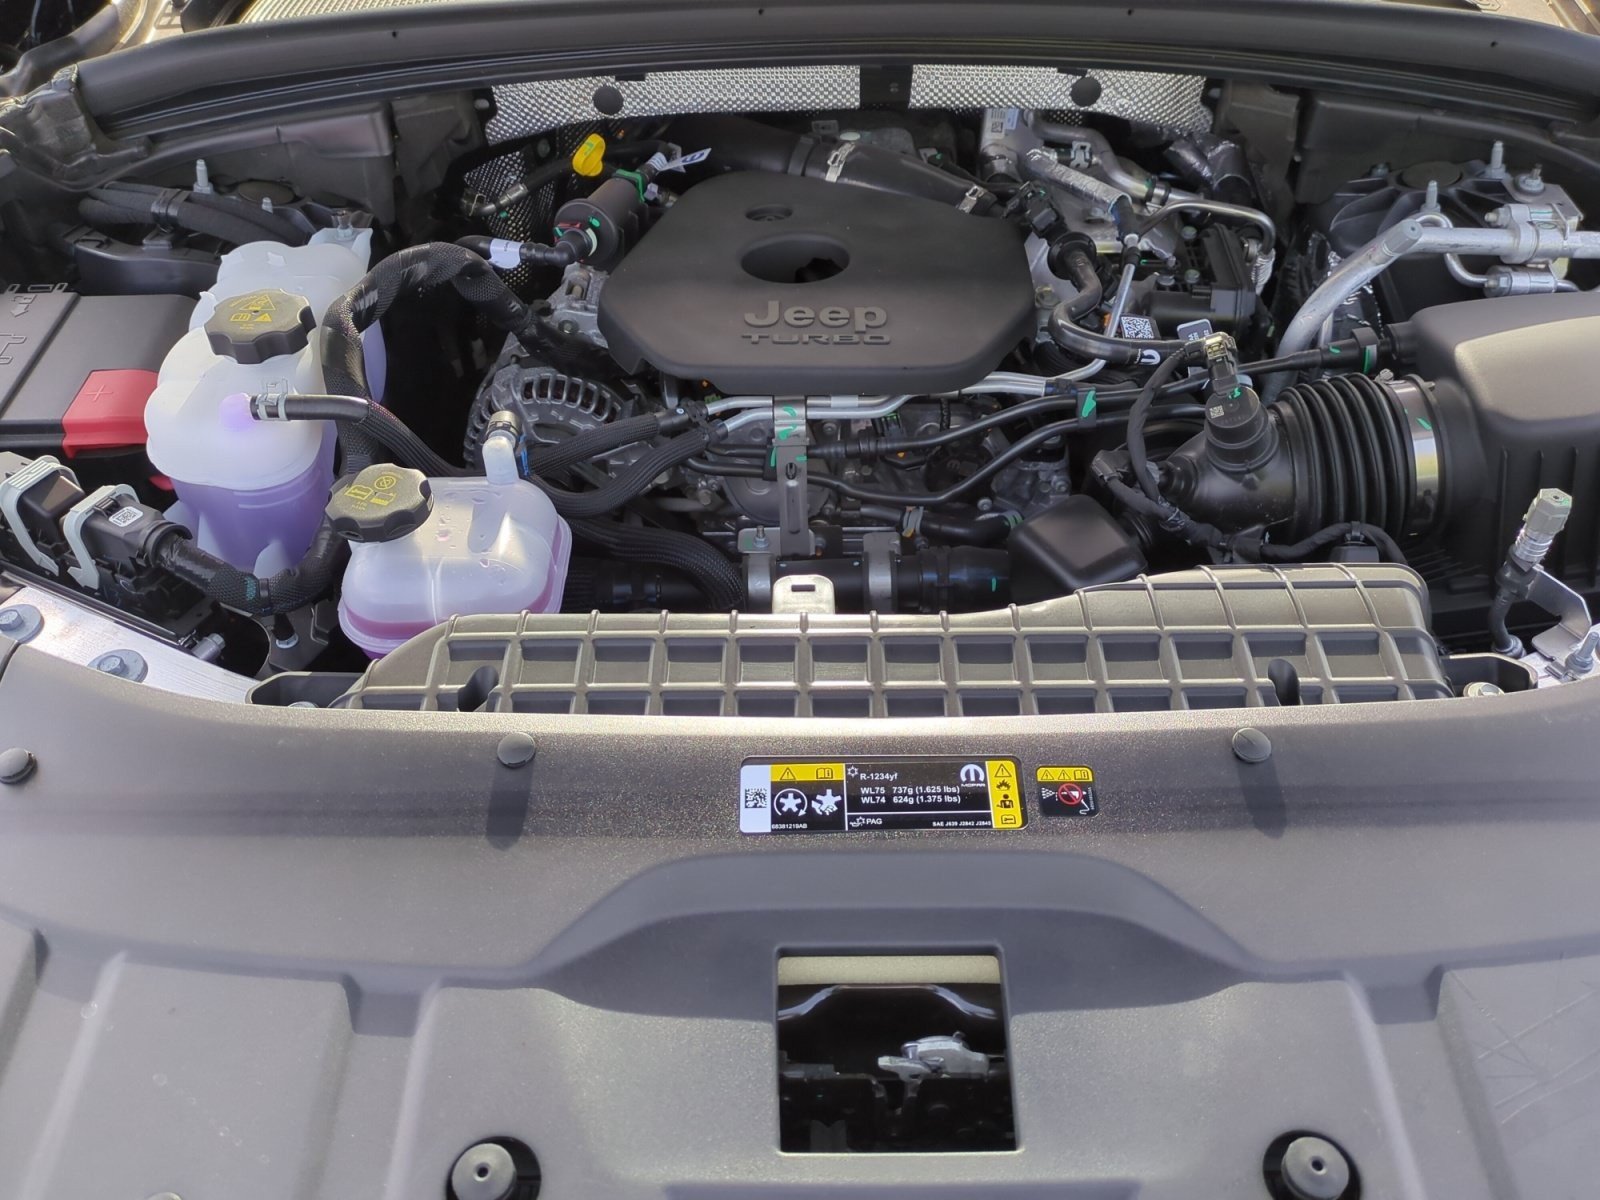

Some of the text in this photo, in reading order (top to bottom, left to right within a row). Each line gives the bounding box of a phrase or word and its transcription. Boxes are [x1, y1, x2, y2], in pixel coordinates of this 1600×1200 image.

[744, 300, 887, 333] Jeep
[741, 333, 891, 344] TURBO
[860, 772, 898, 781] R-1234yf
[860, 785, 960, 795] WL75 737g (1.625 lbs)
[860, 795, 961, 804] WL74 624g (1.375 lbs)
